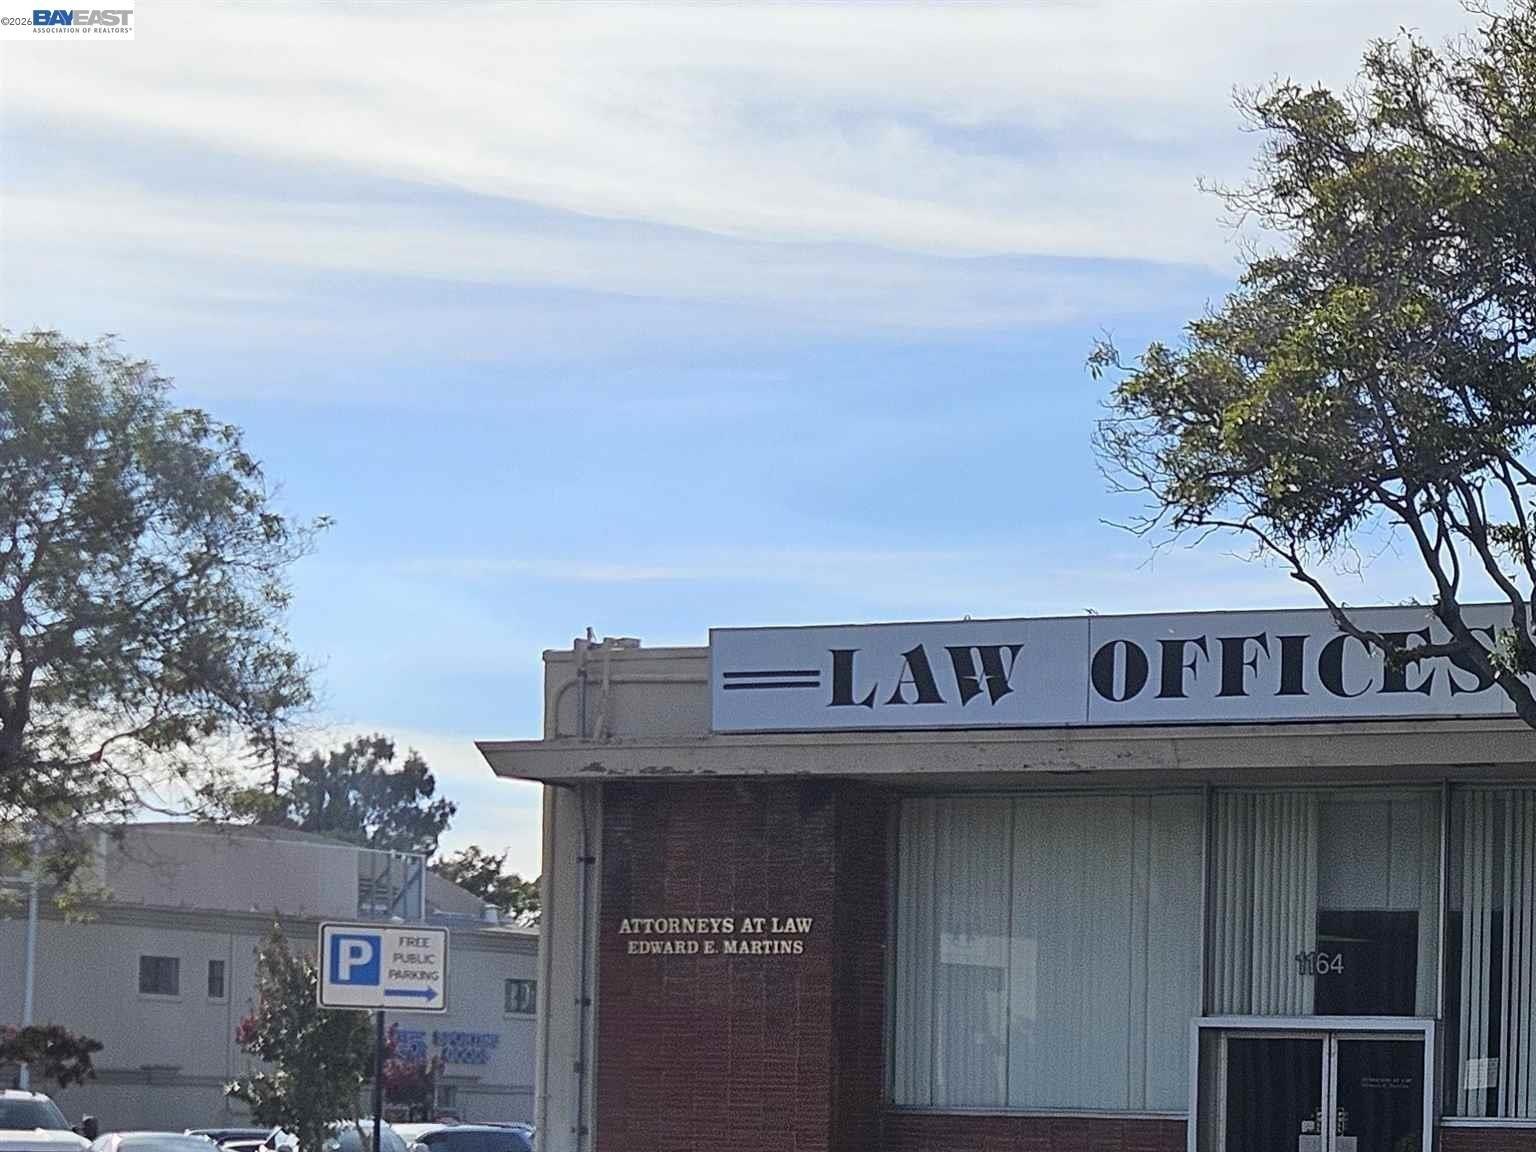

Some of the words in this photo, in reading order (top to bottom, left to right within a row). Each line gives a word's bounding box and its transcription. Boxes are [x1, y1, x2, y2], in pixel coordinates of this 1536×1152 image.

[826, 643, 1025, 710] LAW
[619, 918, 735, 934] ATTORNEYS
[740, 918, 767, 933] AT
[771, 917, 814, 933] LAW
[398, 936, 431, 948] FREE
[627, 940, 699, 955] EDWARD
[703, 940, 719, 954] E.
[723, 940, 804, 954] MARTINS
[338, 939, 373, 981] P
[393, 952, 436, 964] PUBLIC
[1295, 951, 1345, 976] 1164
[388, 968, 440, 981] PARKING
